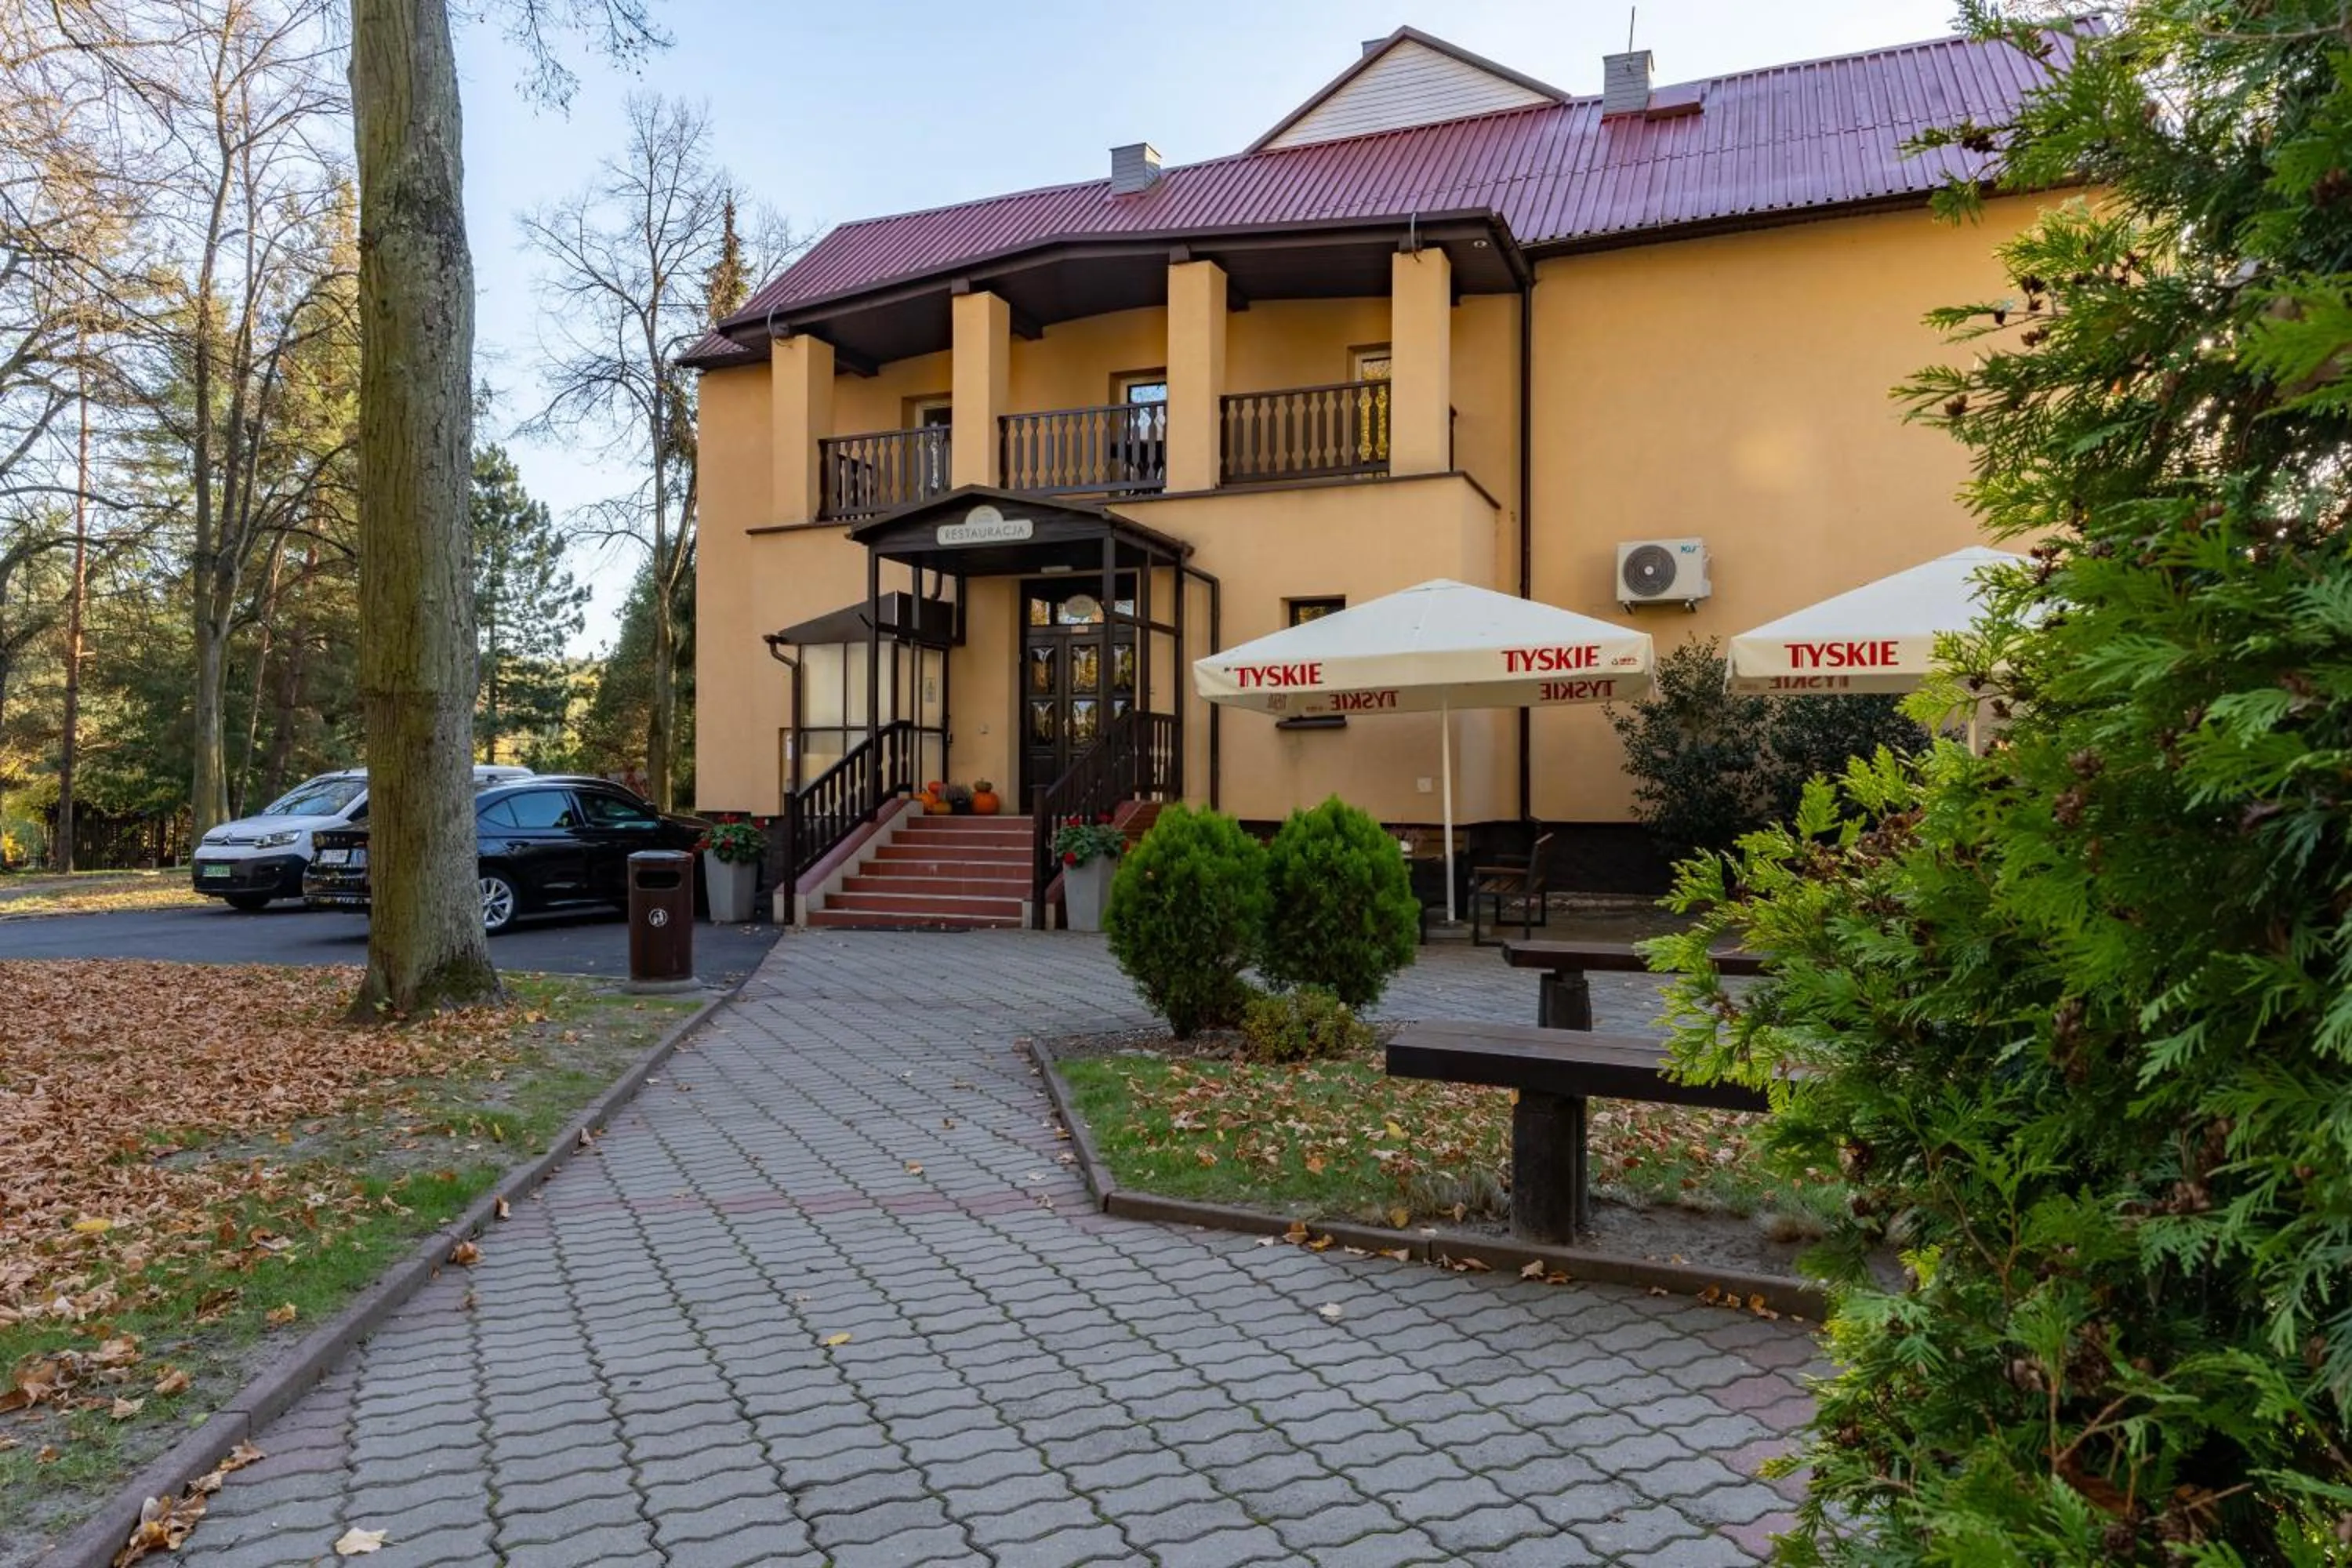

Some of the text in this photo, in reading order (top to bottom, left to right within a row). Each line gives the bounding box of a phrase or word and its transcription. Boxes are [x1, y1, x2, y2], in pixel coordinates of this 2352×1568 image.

[945, 524, 1025, 540] RESTAURACJA
[1501, 645, 1601, 672] TYSKIE
[1784, 641, 1899, 668] TYSKIE
[1234, 663, 1323, 687] TYSKIE
